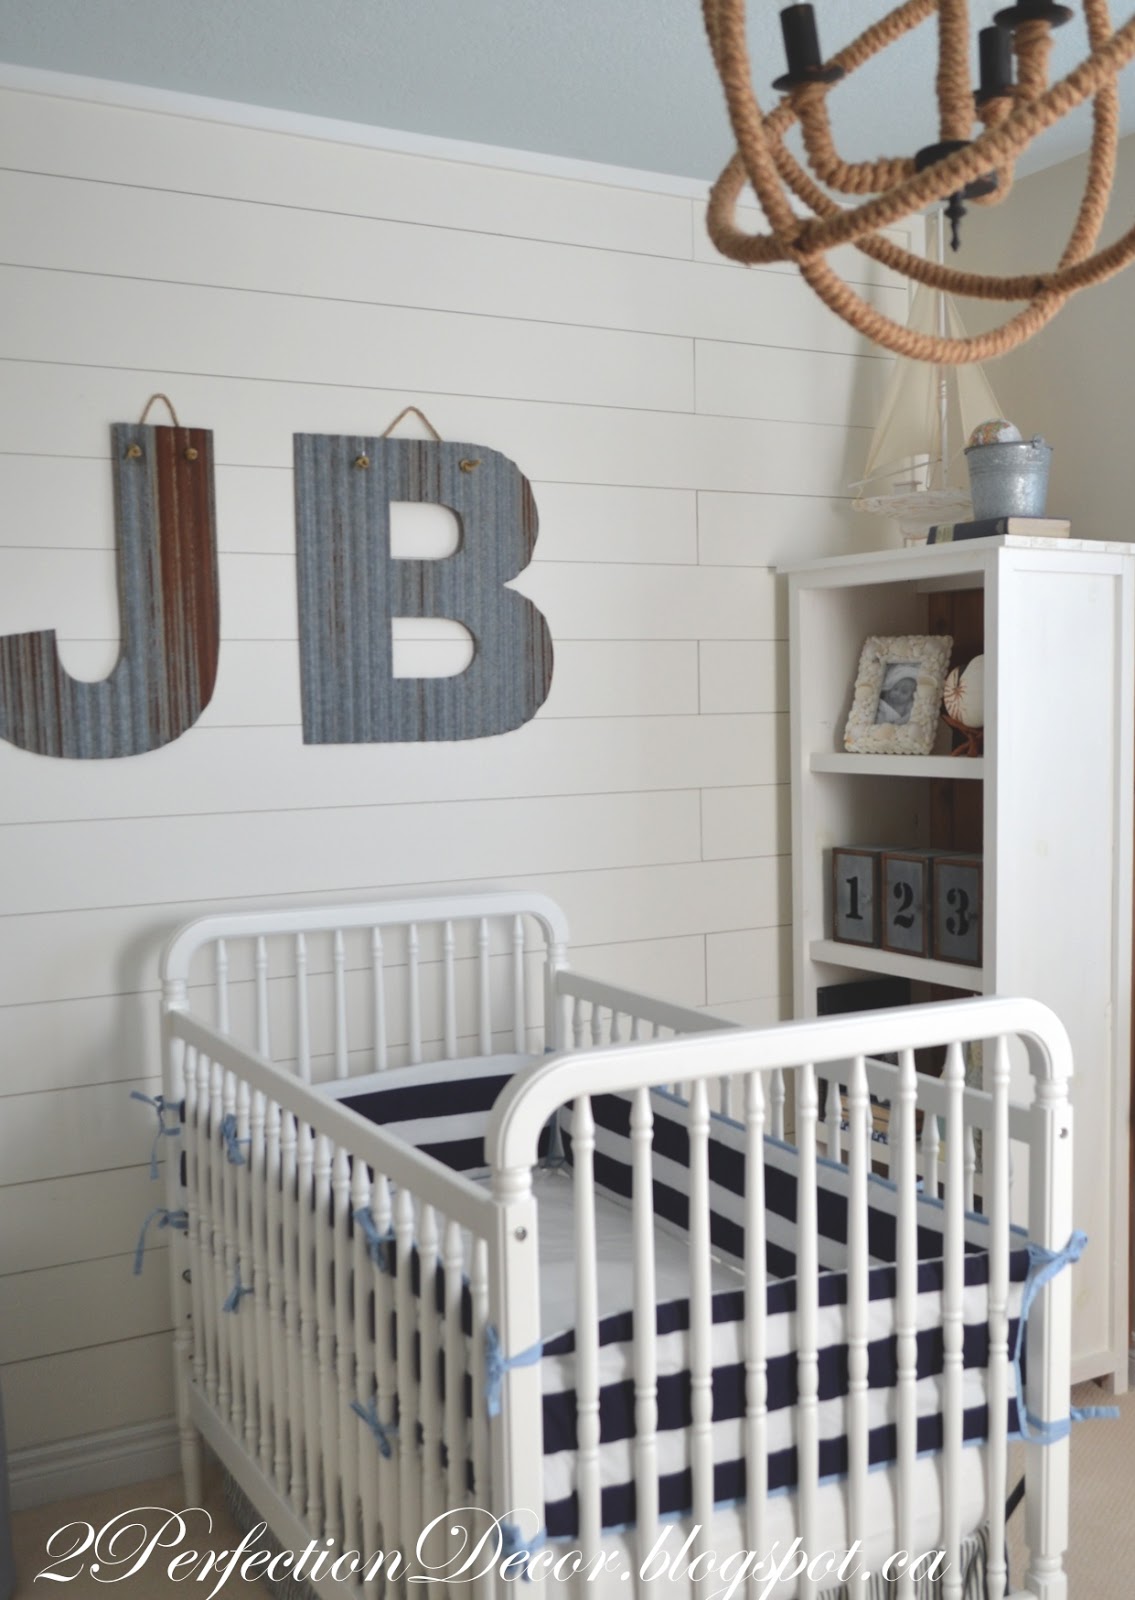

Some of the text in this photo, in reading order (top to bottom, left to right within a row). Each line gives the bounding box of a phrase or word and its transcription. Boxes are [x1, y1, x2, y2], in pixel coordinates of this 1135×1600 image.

[0, 422, 554, 759] J B
[845, 876, 969, 936] 1 2 3
